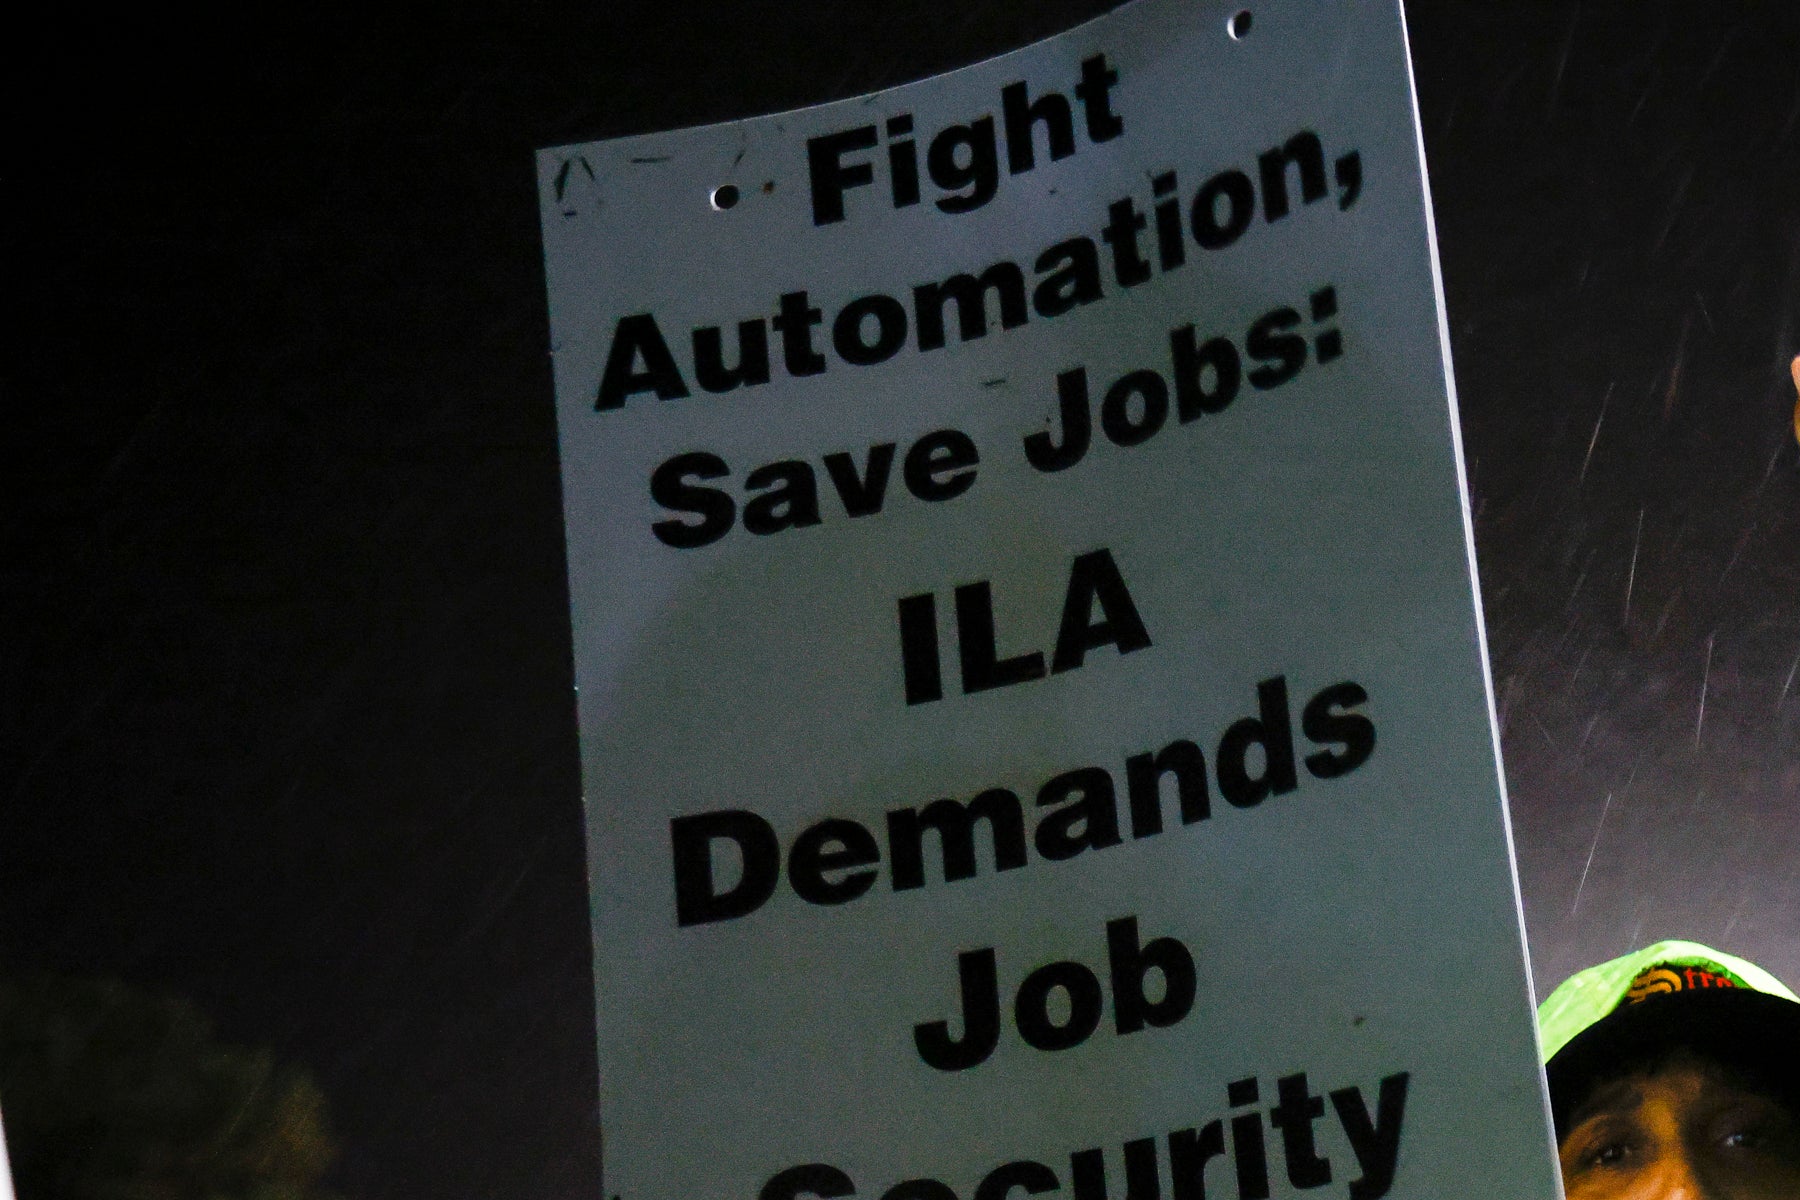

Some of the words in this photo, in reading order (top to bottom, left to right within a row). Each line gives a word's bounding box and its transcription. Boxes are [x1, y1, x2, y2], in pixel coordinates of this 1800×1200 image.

[807, 53, 1125, 227] Fight
[593, 127, 1363, 412] Automation,
[650, 429, 980, 549] Save
[1023, 285, 1345, 473] Jobs:
[897, 546, 1152, 706] ILA
[669, 675, 1377, 928] Demands
[914, 915, 1197, 1073] Job
